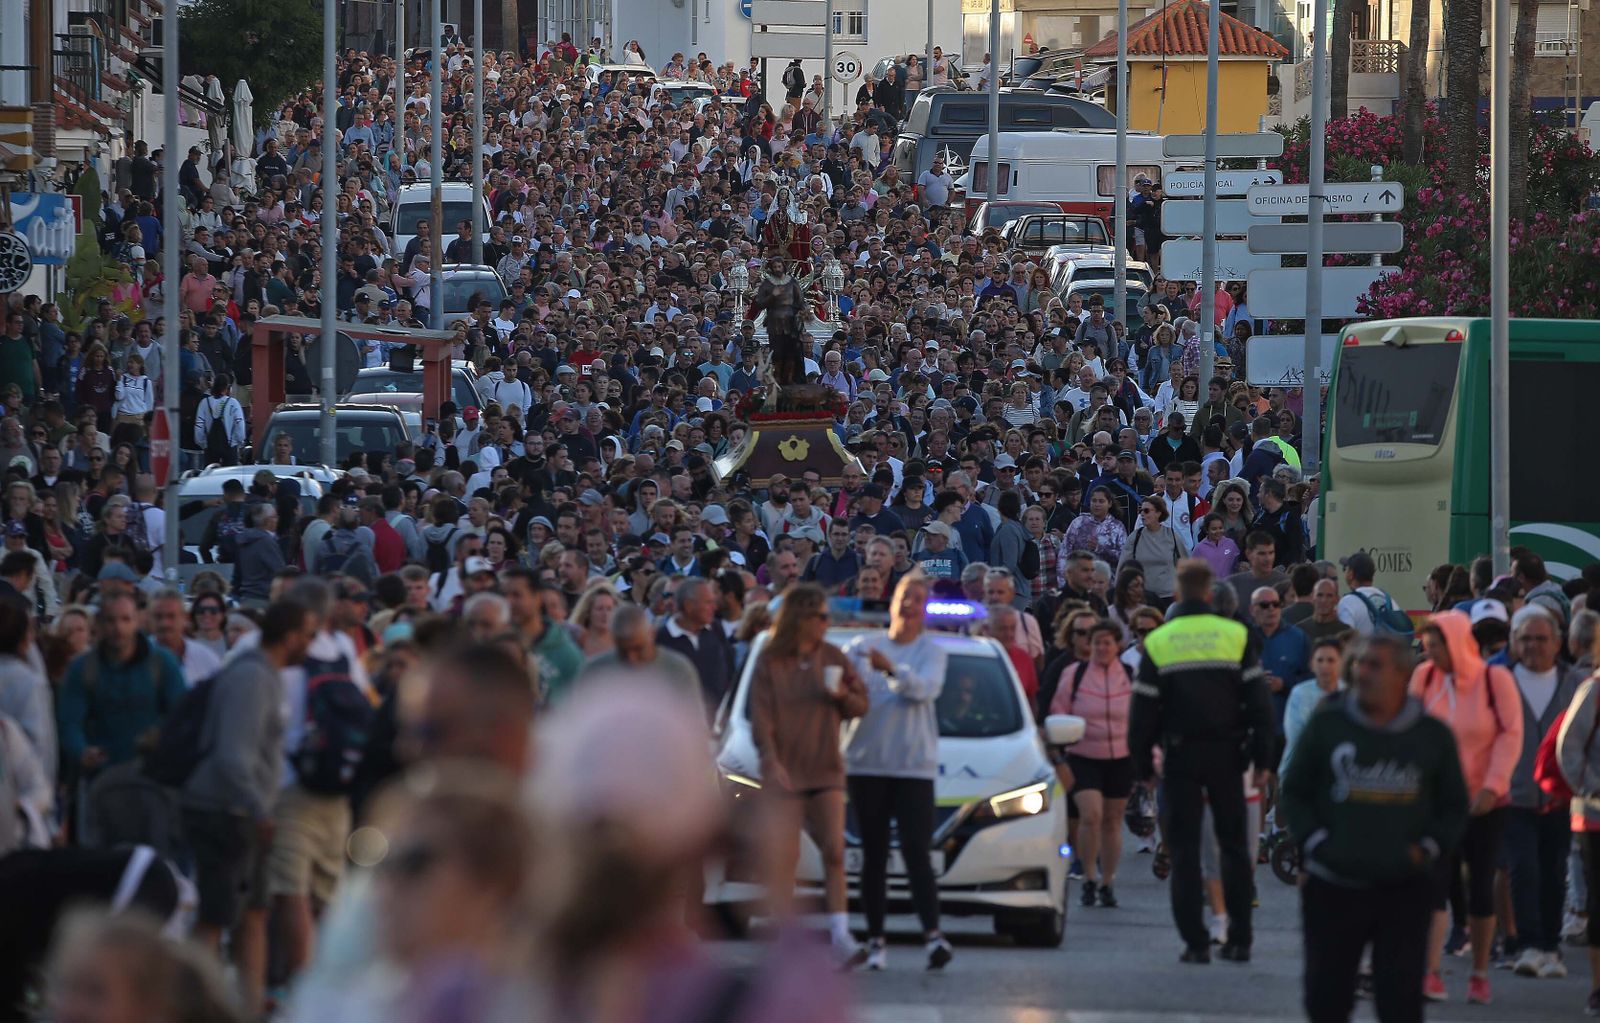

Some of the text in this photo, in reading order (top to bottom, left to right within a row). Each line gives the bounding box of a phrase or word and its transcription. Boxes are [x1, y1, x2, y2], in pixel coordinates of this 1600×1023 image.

[837, 62, 856, 73] 30
[1255, 196, 1293, 205] OFICINA
[1295, 195, 1308, 204] DE
